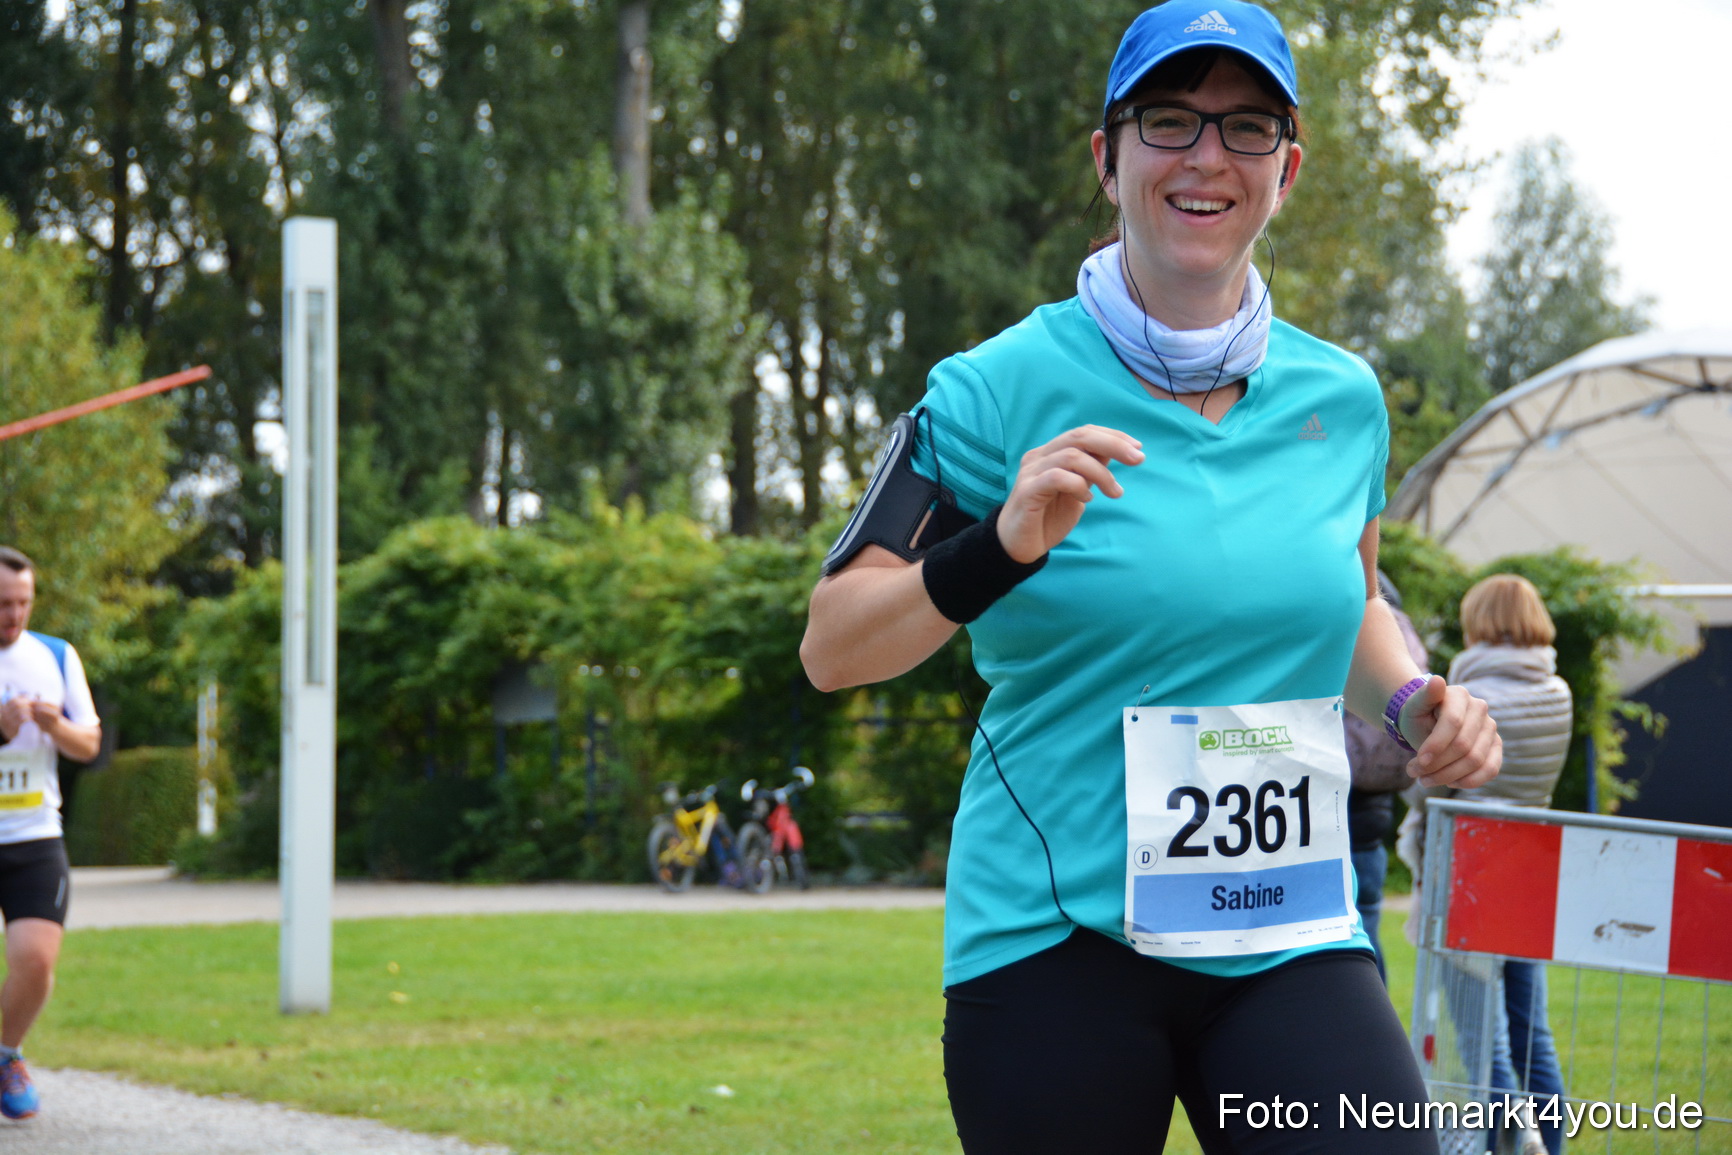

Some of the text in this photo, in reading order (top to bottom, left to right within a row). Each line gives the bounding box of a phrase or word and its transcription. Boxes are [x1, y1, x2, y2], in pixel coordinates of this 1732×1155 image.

[1183, 22, 1237, 35] adidas
[1297, 430, 1328, 441] adidas
[1223, 726, 1292, 749] BOCK
[1223, 749, 1248, 758] inspired
[1249, 748, 1258, 756] by
[1166, 775, 1310, 858] 2361
[1141, 851, 1150, 864] D
[1211, 883, 1284, 911] Sabine
